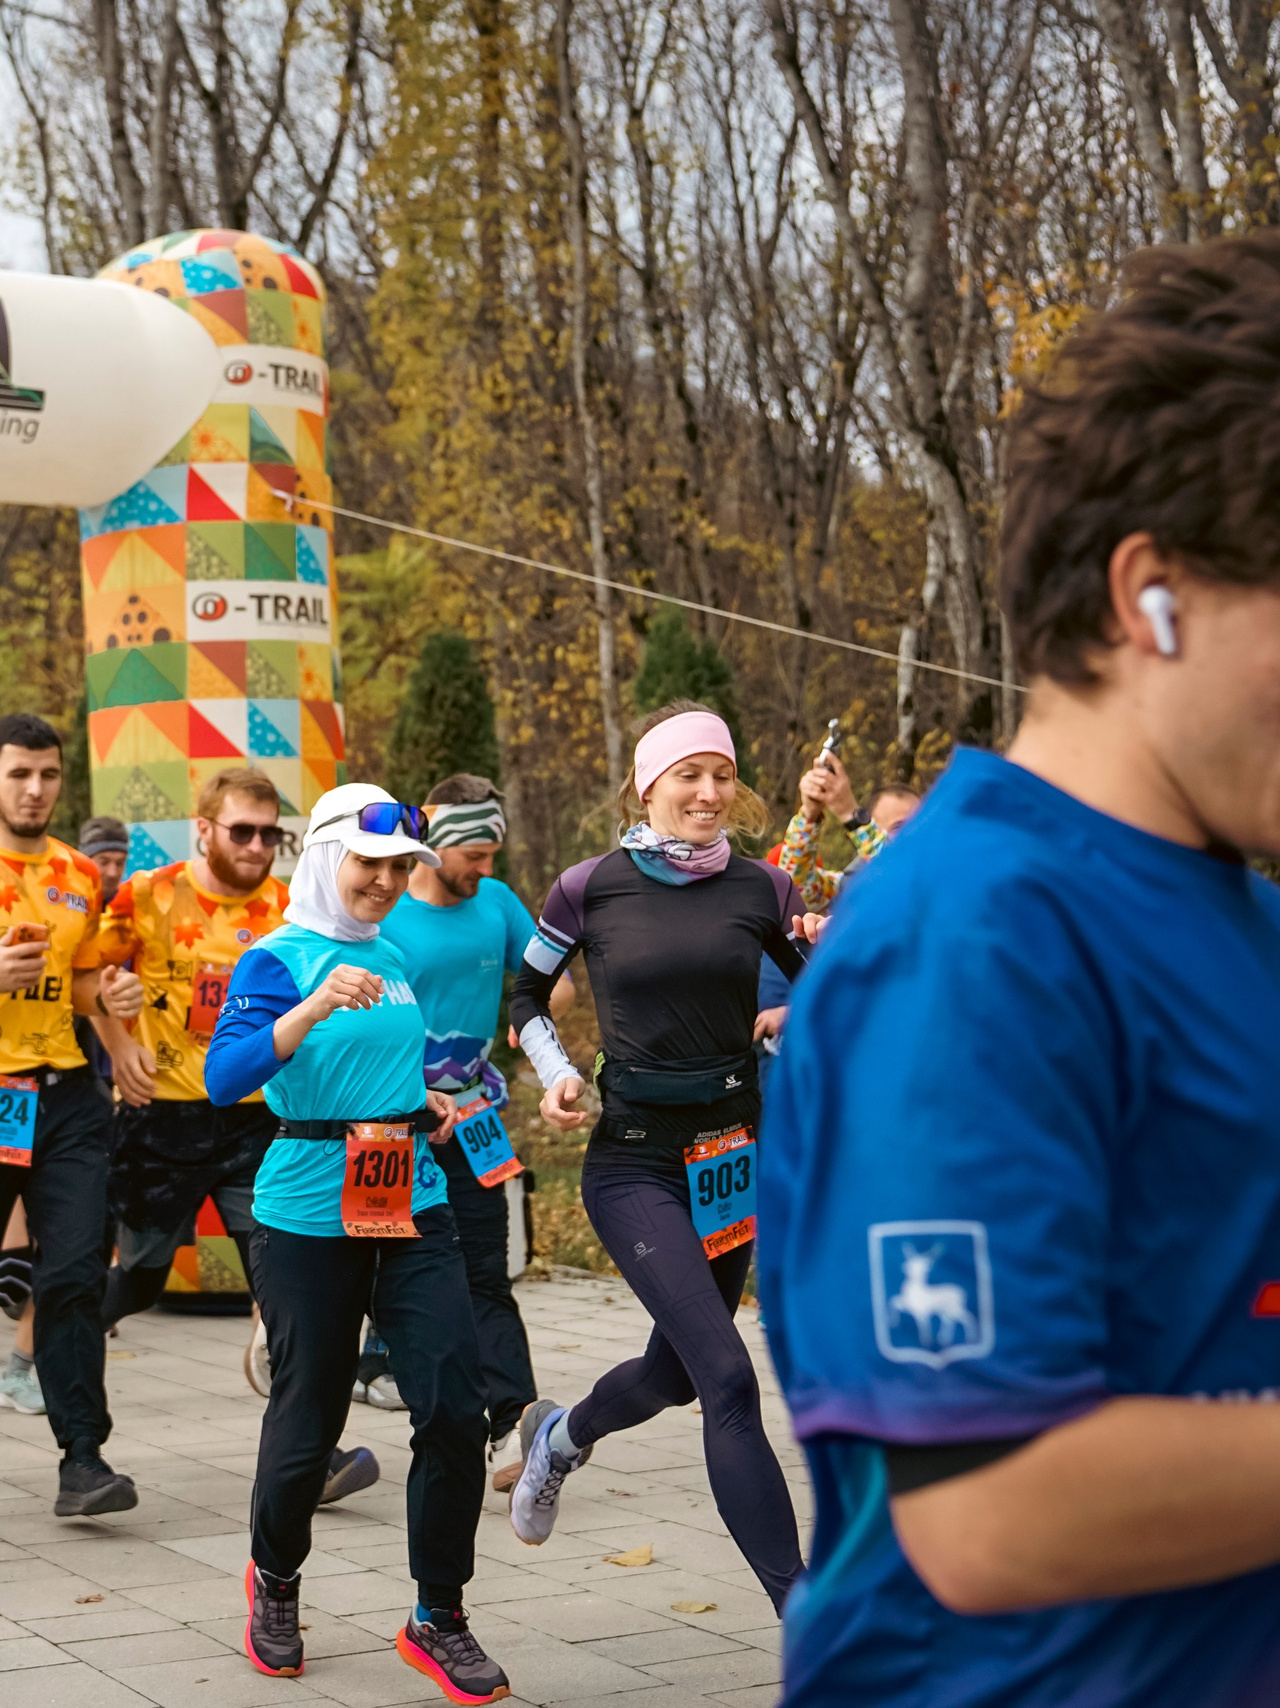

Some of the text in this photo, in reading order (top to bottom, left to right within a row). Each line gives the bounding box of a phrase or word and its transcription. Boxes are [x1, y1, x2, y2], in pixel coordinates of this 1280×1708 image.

[199, 980, 229, 1008] 13
[463, 1114, 502, 1154] 904
[353, 1150, 410, 1188] 1301
[697, 1154, 751, 1207] 903
